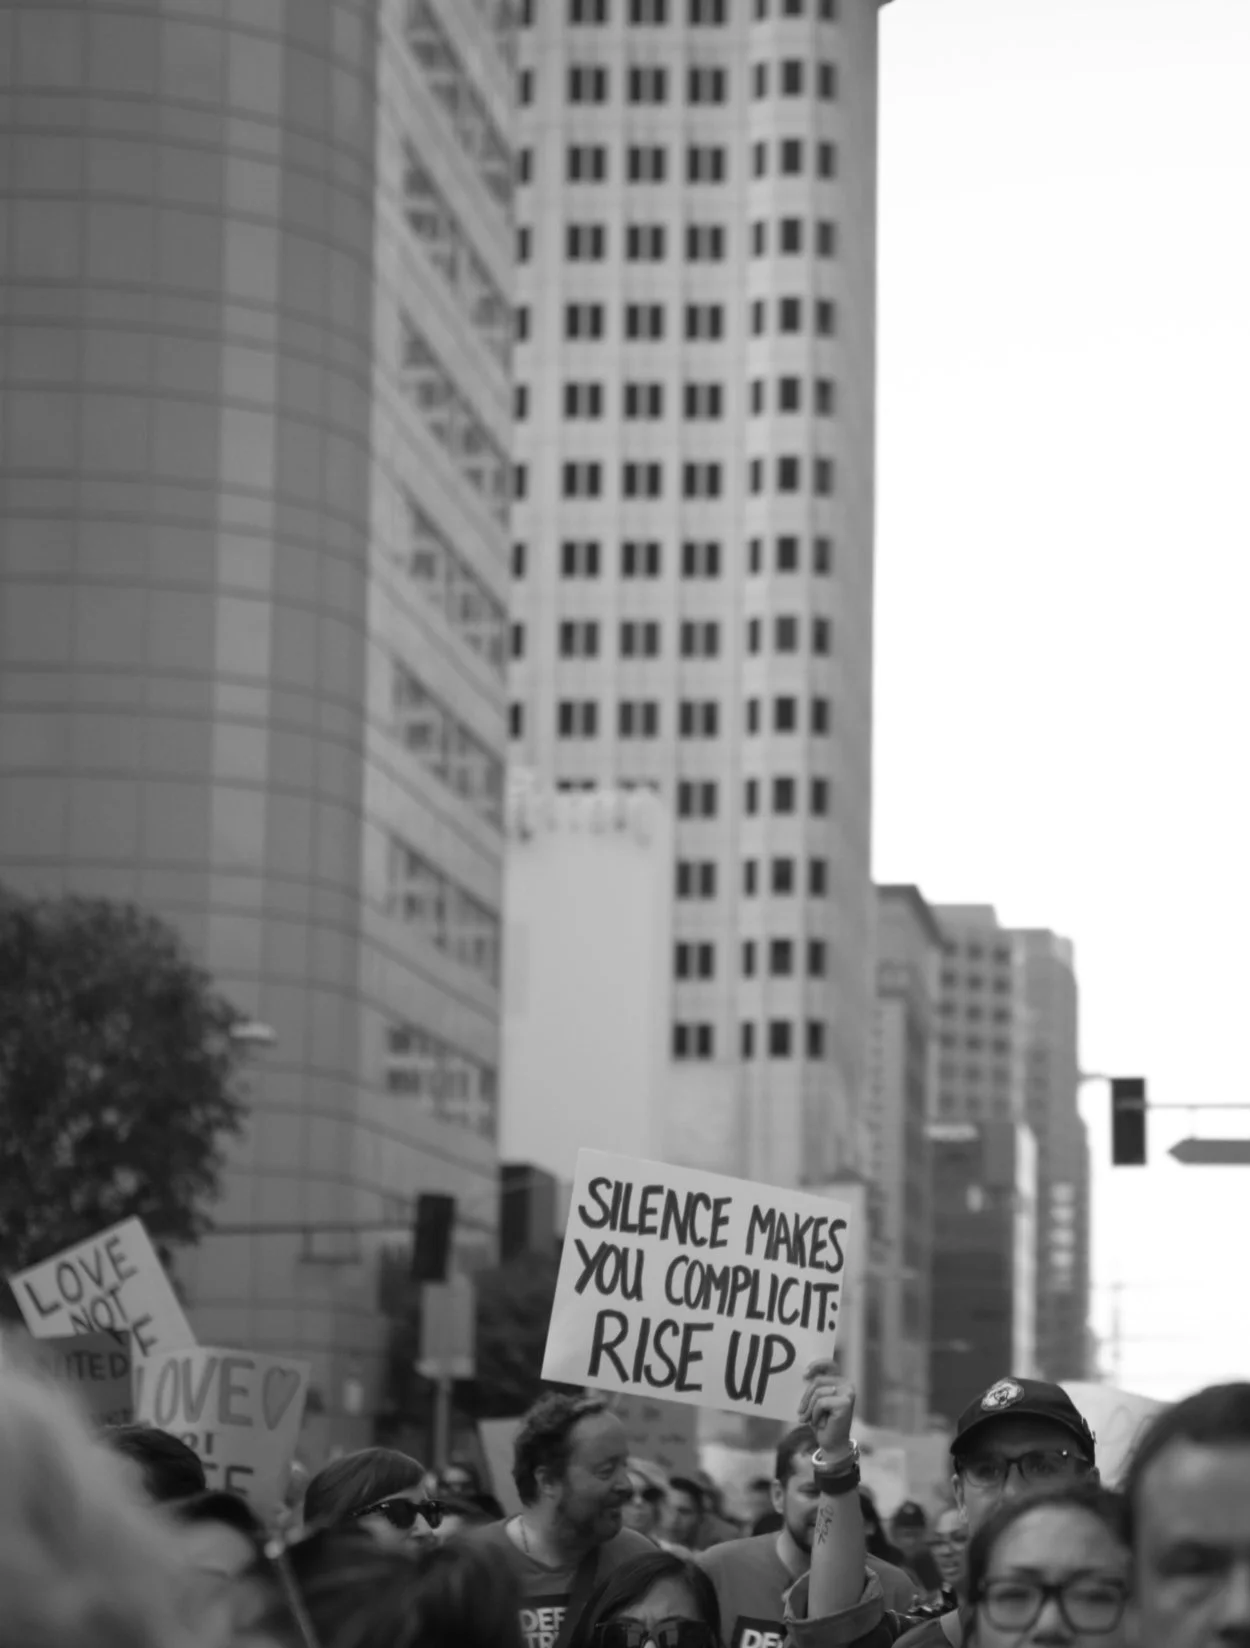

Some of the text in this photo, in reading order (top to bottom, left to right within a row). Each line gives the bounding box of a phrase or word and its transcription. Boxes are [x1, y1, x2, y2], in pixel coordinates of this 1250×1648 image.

[578, 1176, 848, 1274] SILENCE MAKES
[24, 1235, 139, 1318] LOVE
[69, 1284, 130, 1336] NOT
[573, 1237, 841, 1333] YOU COMPLICIT:
[587, 1309, 797, 1406] RISE UP
[518, 1606, 569, 1632] DEF
